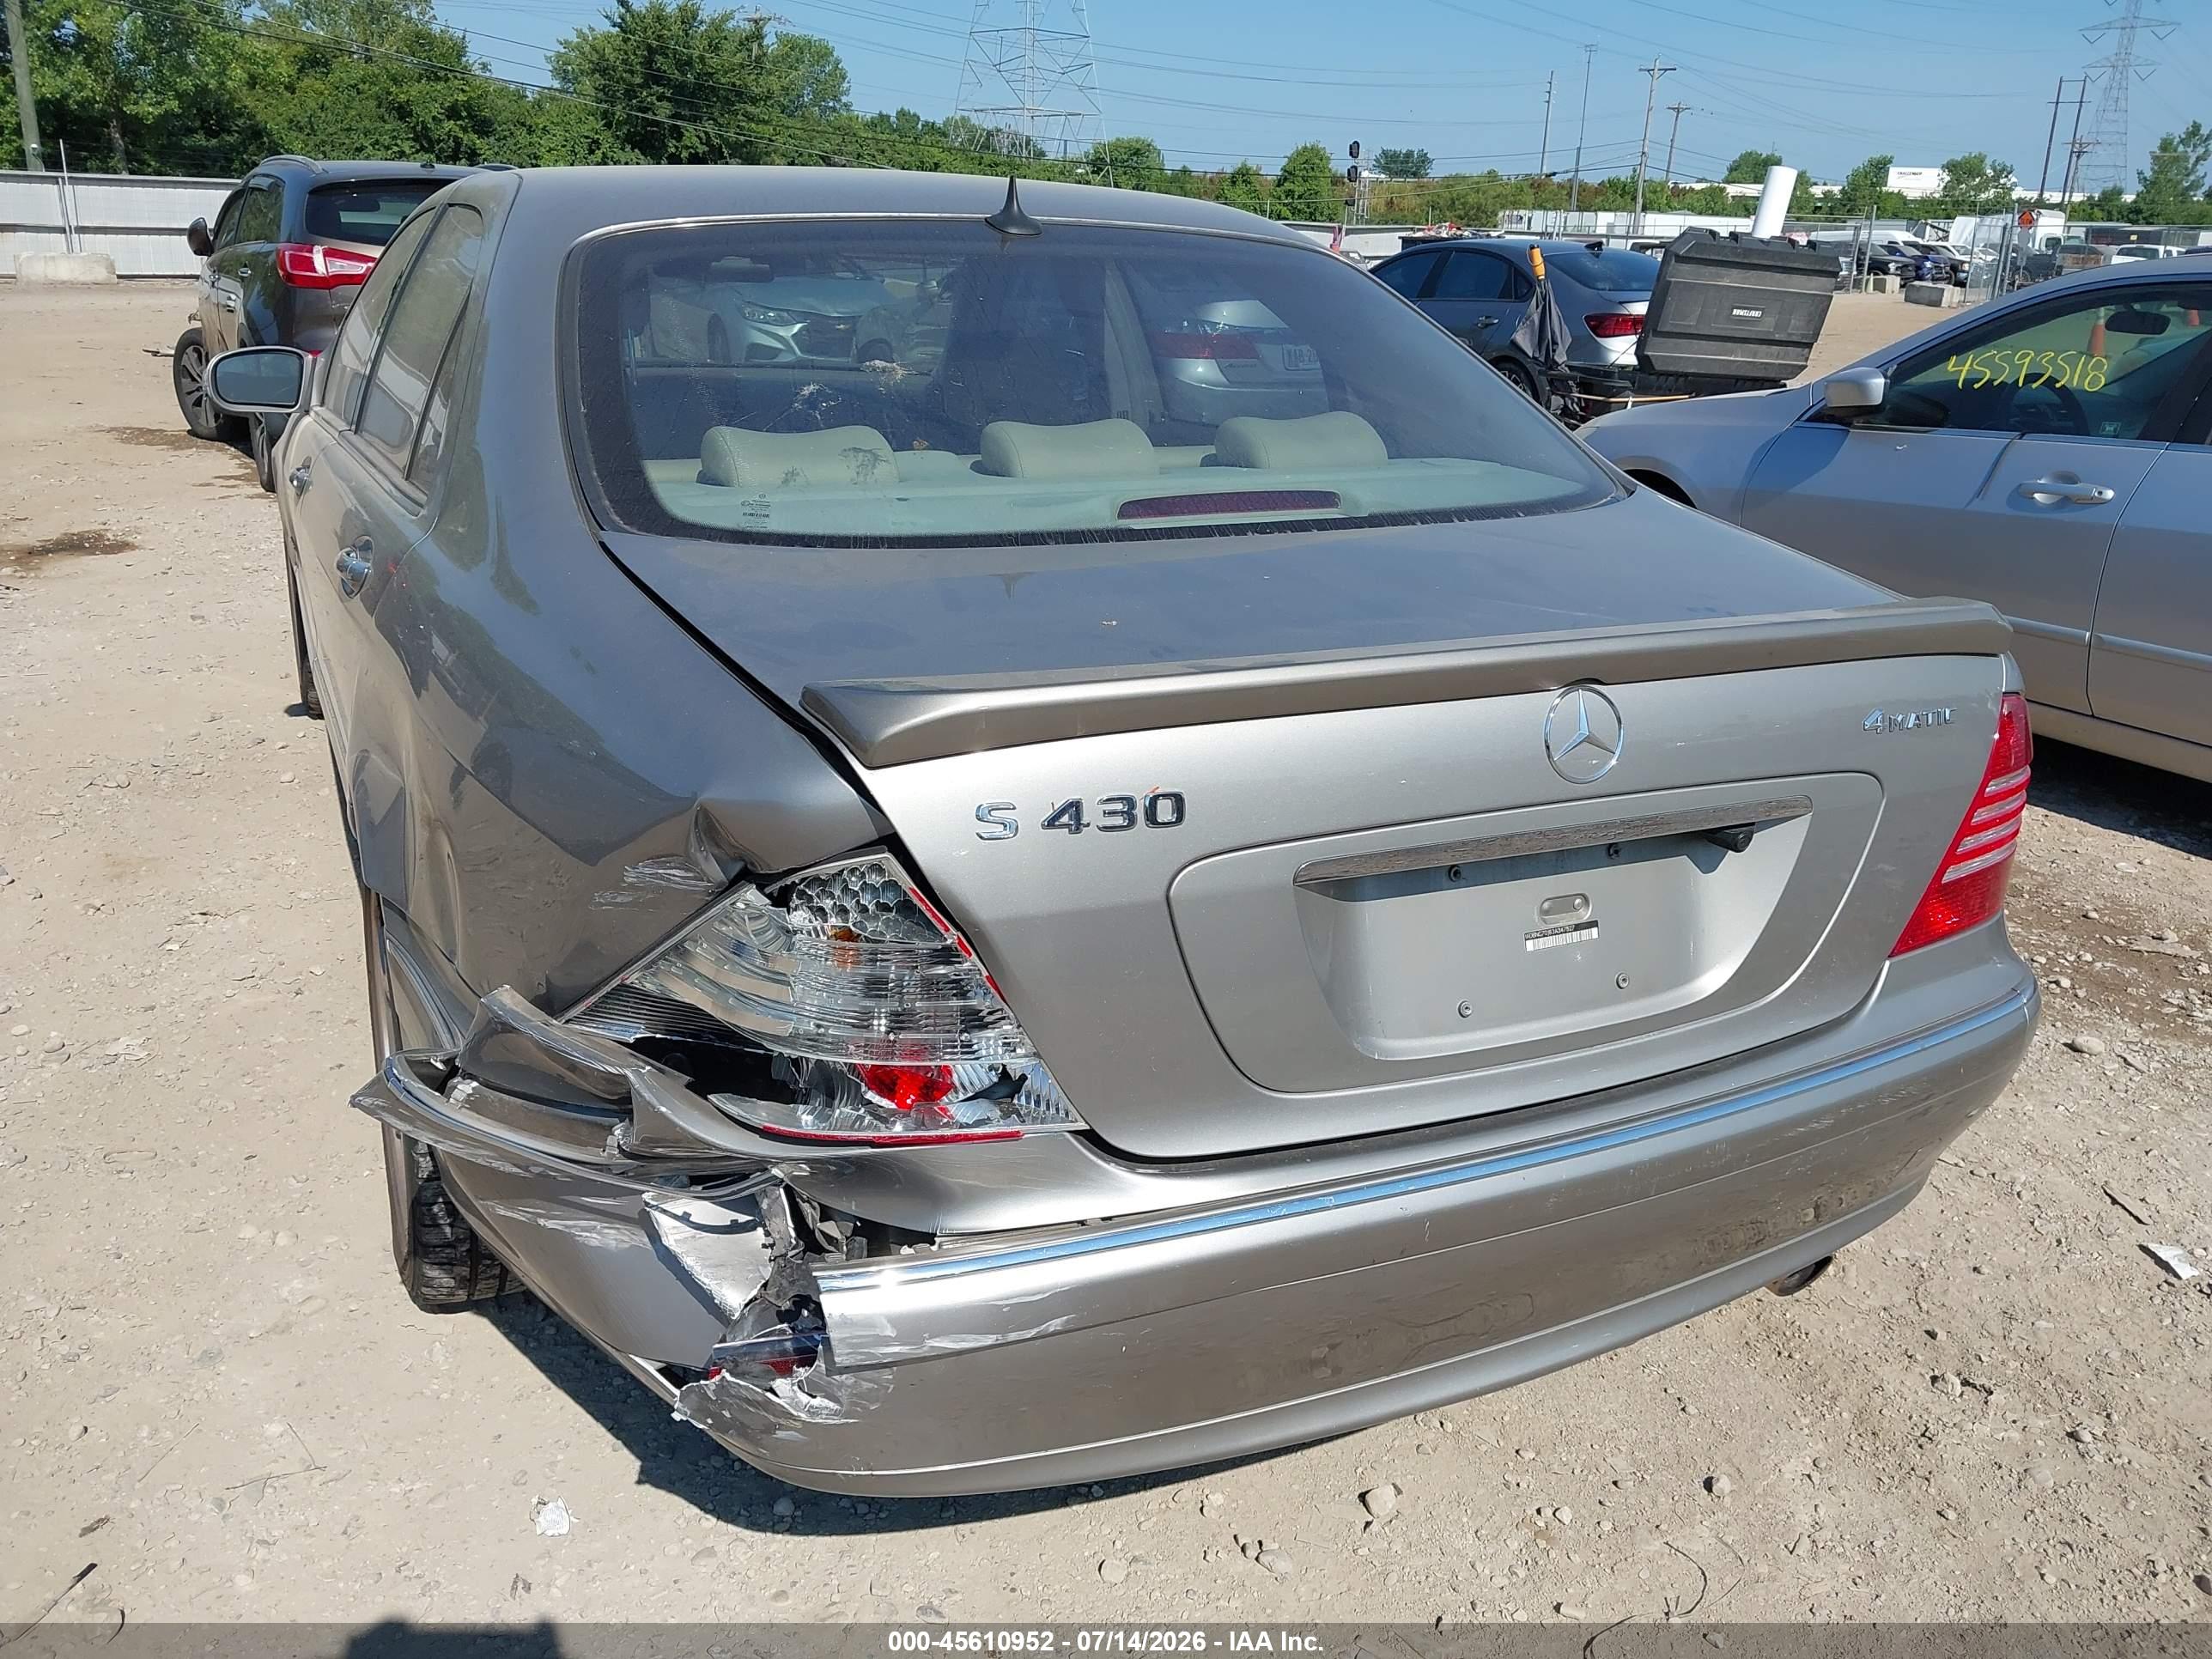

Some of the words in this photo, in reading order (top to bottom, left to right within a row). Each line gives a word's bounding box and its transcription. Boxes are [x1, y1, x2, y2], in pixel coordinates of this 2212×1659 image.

[1947, 349, 2108, 392] 45593518
[975, 800, 1019, 841] S
[1041, 791, 1187, 835] 430
